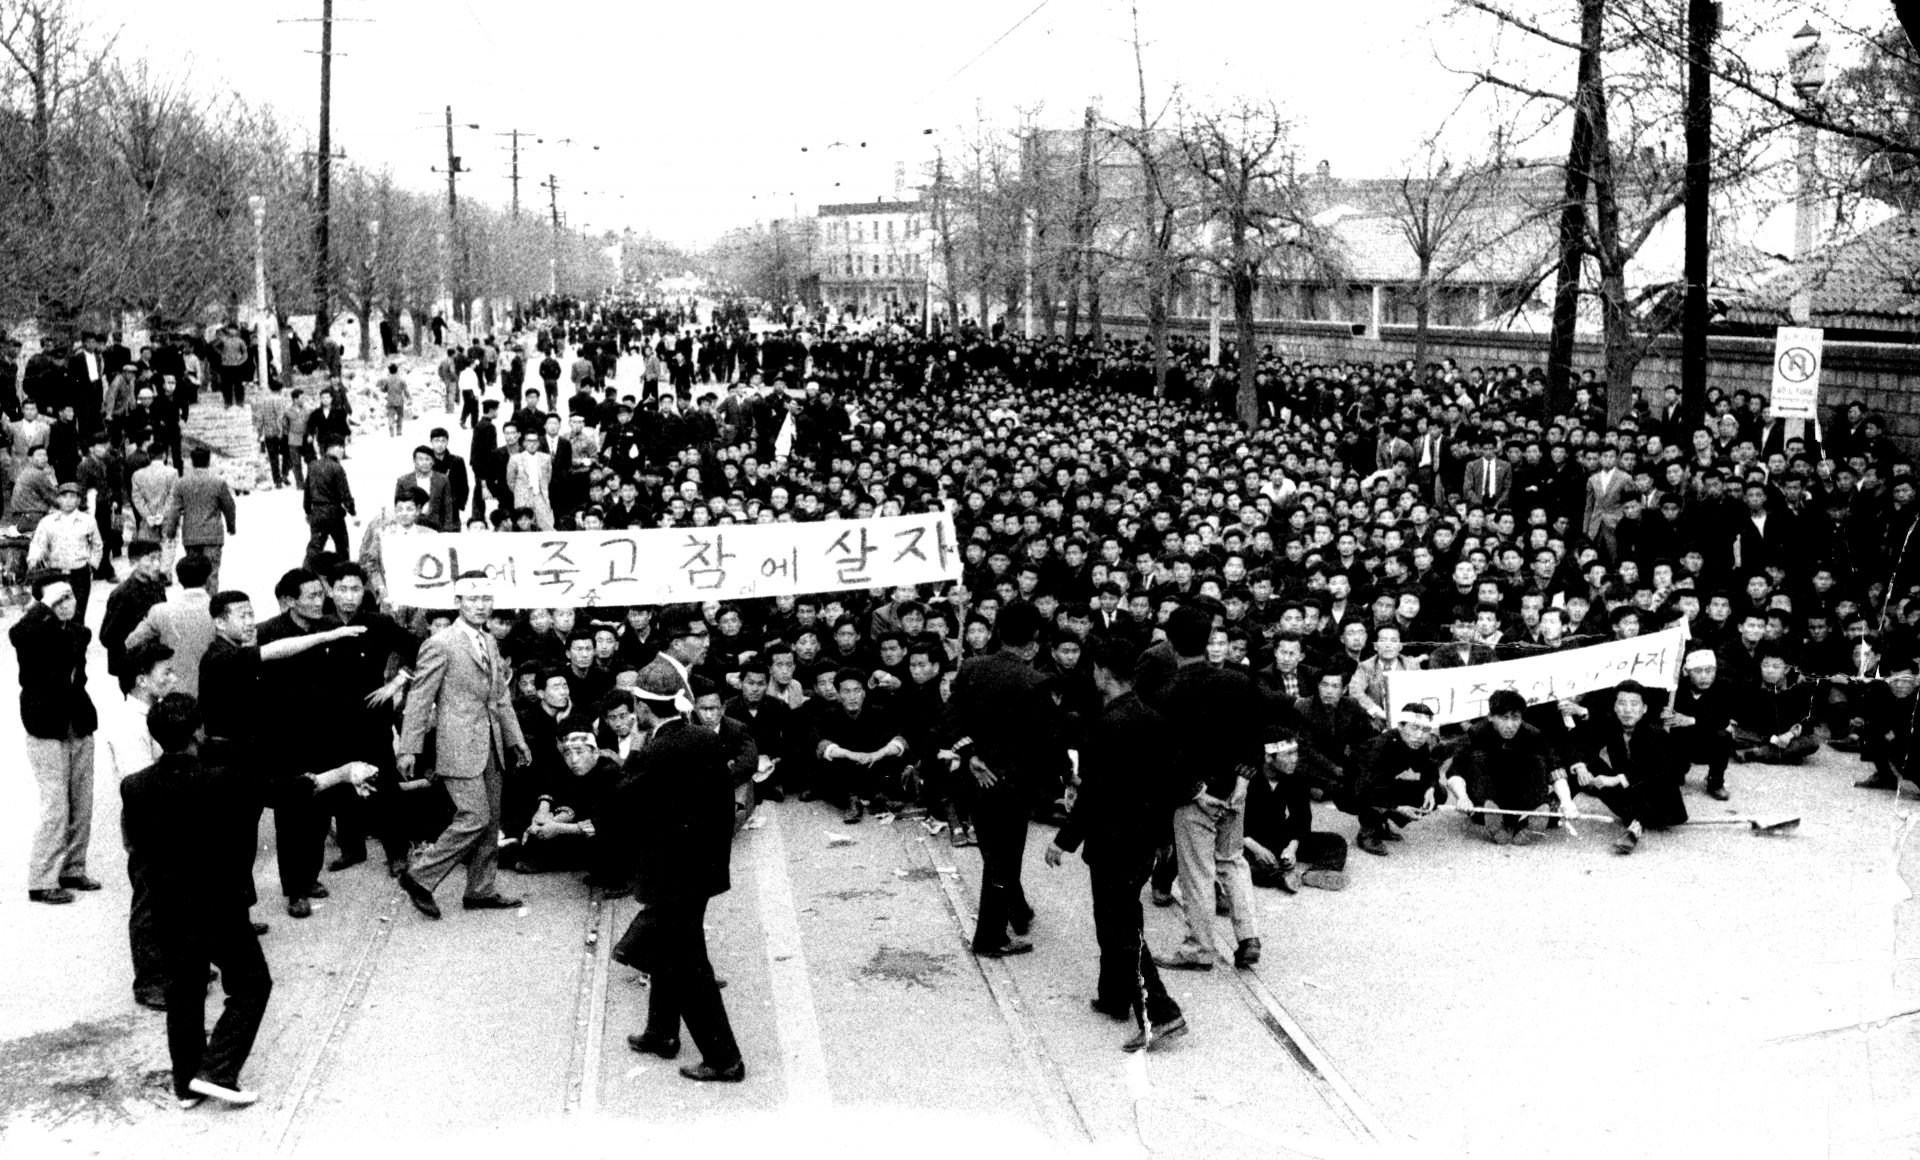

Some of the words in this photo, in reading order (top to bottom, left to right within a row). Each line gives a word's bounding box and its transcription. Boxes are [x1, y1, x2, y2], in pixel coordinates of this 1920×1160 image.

[414, 546, 516, 590] 의에
[532, 537, 639, 596] 죽고
[679, 533, 798, 591] 참에
[824, 519, 955, 585] 살자
